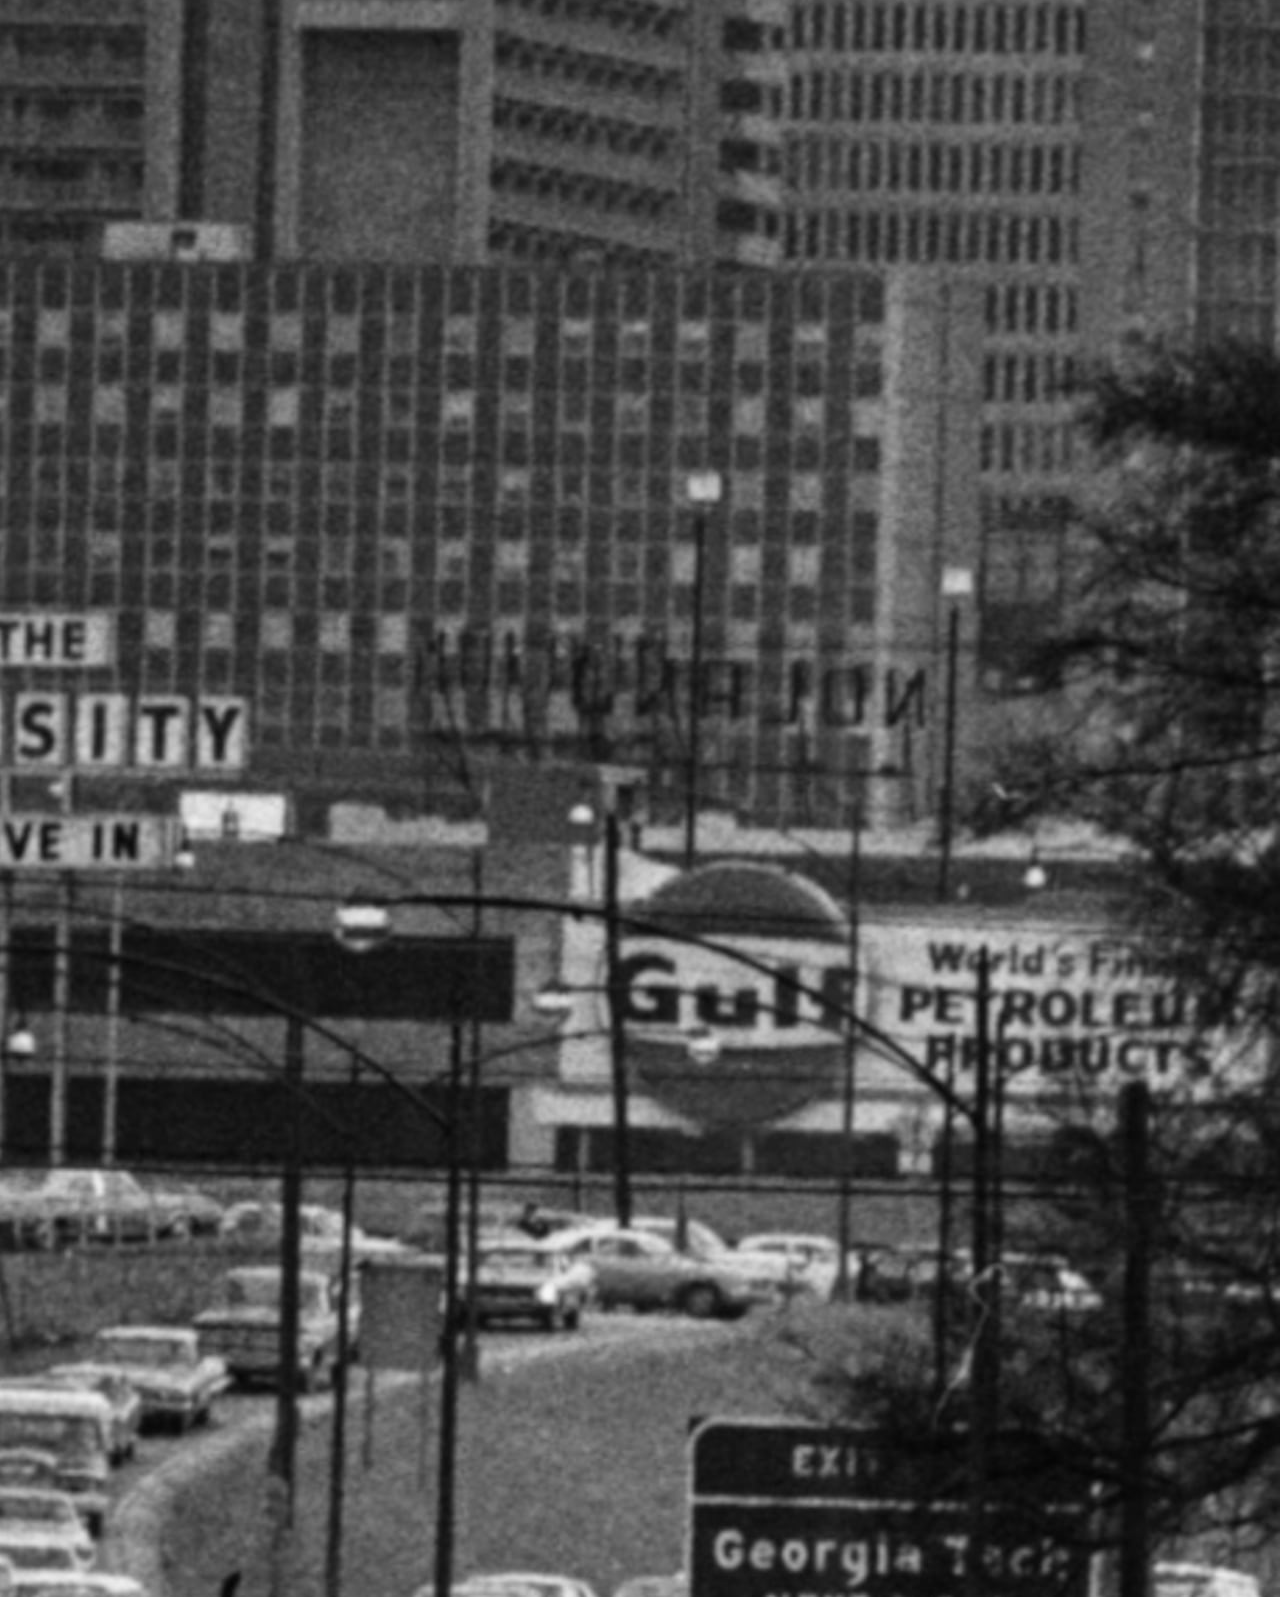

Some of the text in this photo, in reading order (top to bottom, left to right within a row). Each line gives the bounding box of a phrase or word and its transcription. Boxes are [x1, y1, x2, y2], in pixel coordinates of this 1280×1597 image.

[92, 821, 140, 860] IN
[616, 953, 855, 1030] Gulf
[792, 1444, 880, 1478] EXI
[713, 1527, 923, 1587] Georgia
